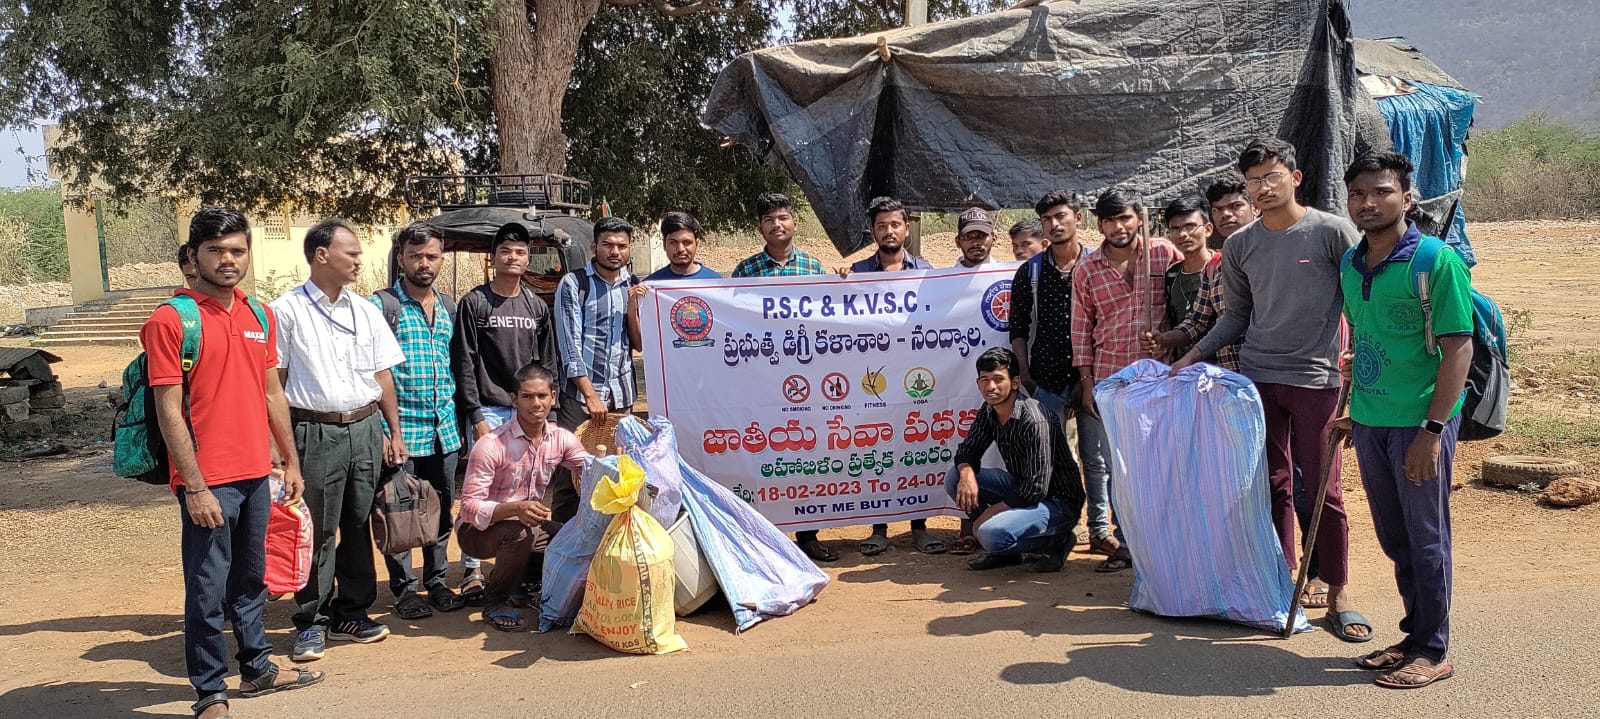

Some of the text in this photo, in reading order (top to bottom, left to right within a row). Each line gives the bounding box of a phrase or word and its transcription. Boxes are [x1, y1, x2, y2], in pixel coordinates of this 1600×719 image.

[762, 296, 813, 319] P.S.C
[821, 295, 836, 317] &
[723, 331, 780, 367] ప్రభుత్వ
[783, 323, 813, 364] డిగ్రీ
[814, 329, 891, 355] కళాశాల
[703, 409, 981, 454] జాతీయ సేవా పథక
[760, 446, 952, 477] అహోబిళం ప్రత్యేక శిబిరం
[757, 480, 862, 502] 18-02-2023
[867, 478, 891, 494] To
[896, 471, 946, 491] 24-02
[794, 494, 929, 515] NOT ME BUT YOU
[616, 596, 636, 609] RICE
[600, 623, 638, 636] ENJOY
[622, 638, 640, 648] KGS
